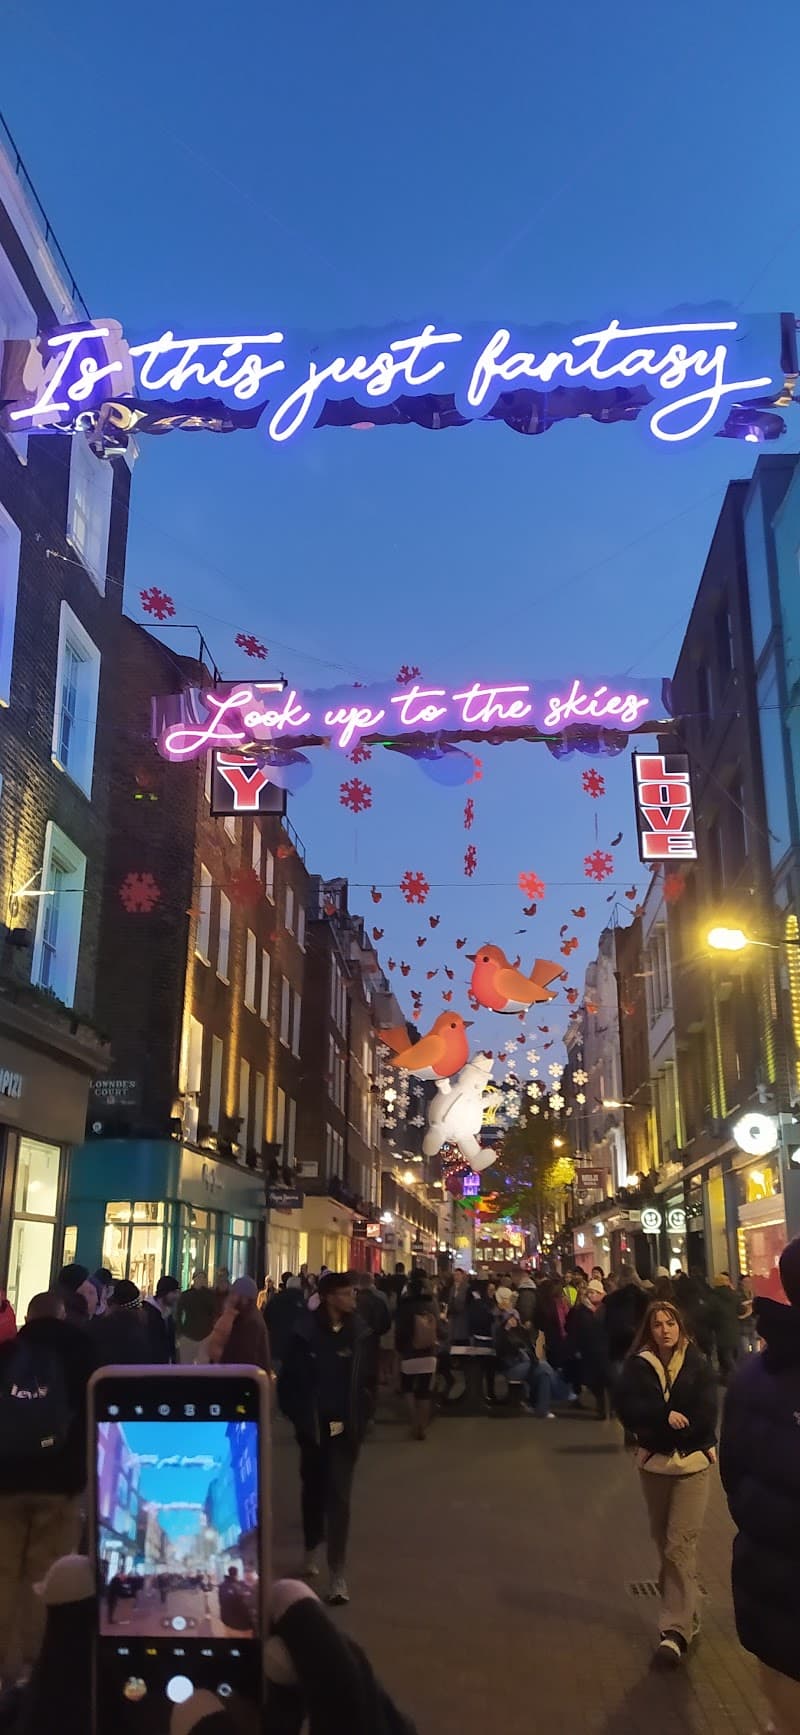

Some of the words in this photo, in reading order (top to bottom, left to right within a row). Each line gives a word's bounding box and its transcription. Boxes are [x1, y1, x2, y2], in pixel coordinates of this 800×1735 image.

[10, 326, 123, 421] Is
[128, 331, 286, 400] this
[268, 325, 463, 442] just
[467, 319, 773, 442] fantasy
[164, 689, 312, 755] Look
[323, 706, 386, 749] up
[390, 684, 448, 726] to
[451, 682, 533, 724] the
[542, 679, 650, 728] skies
[635, 755, 697, 860] LOVE
